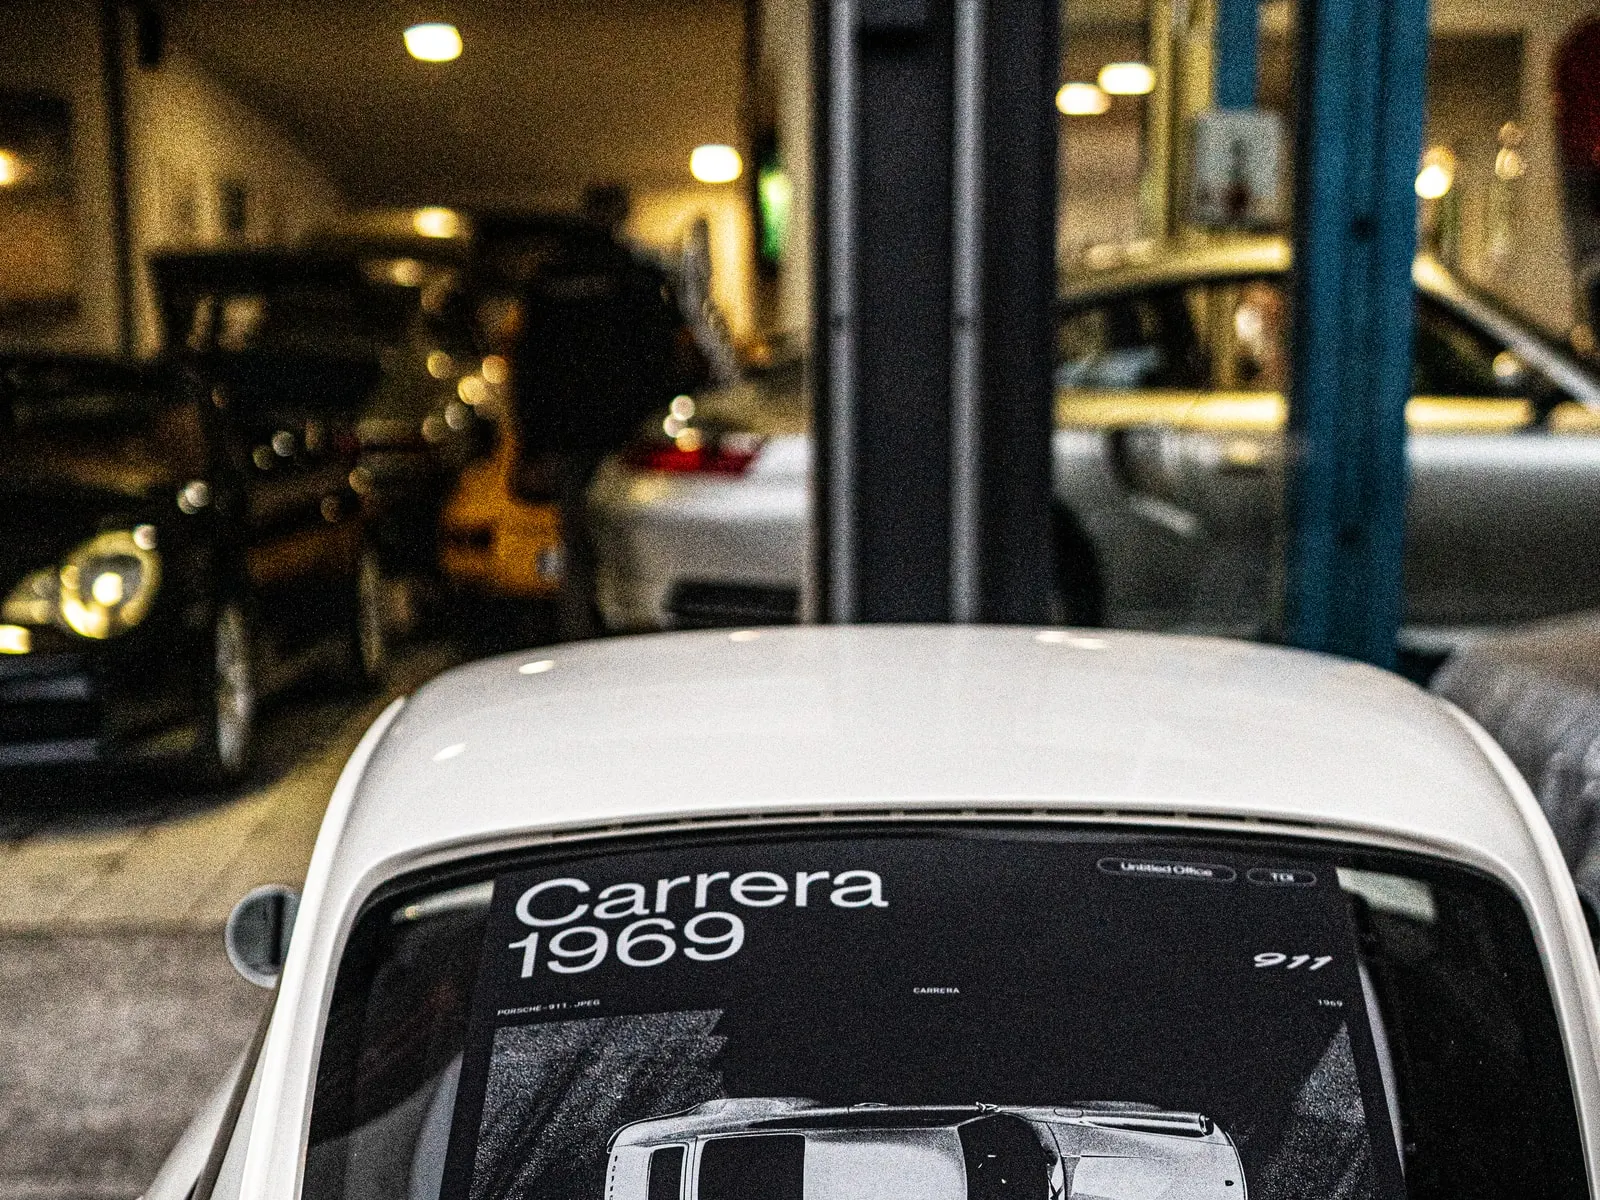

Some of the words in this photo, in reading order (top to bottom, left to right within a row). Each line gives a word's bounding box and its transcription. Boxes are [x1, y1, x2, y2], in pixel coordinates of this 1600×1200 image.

[515, 869, 889, 927] Carrera
[508, 911, 745, 979] 1969
[1253, 952, 1334, 971] 911
[912, 986, 960, 995] CARRERA
